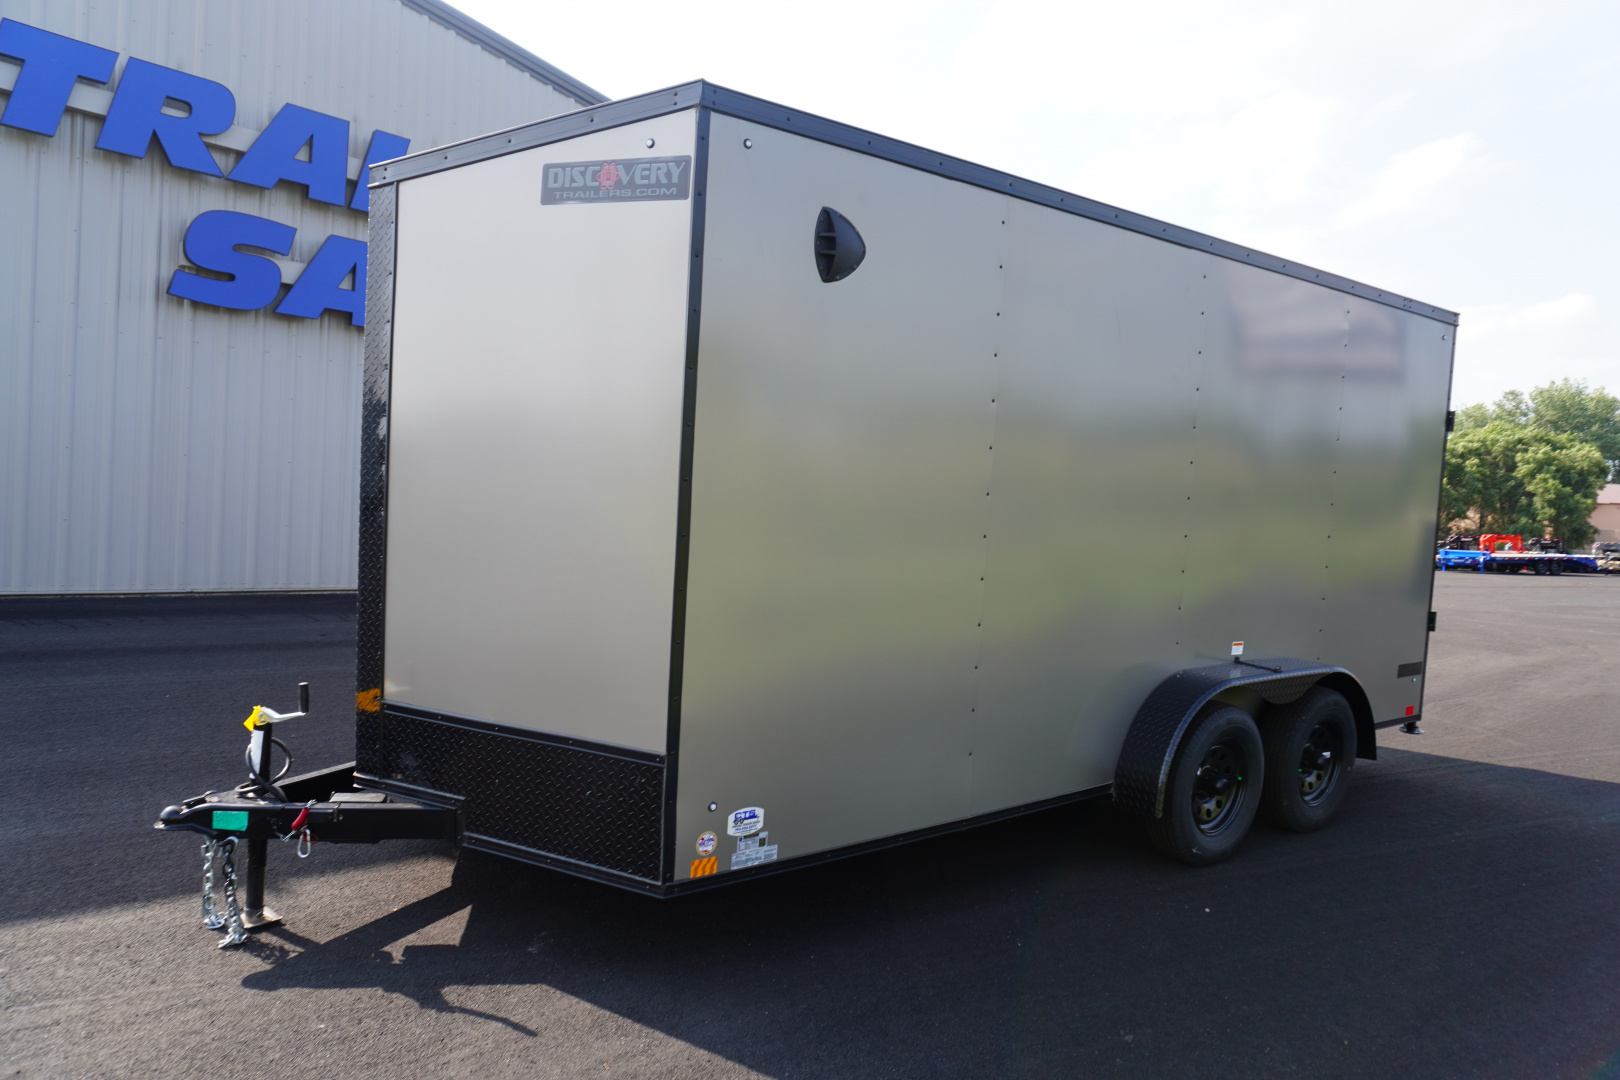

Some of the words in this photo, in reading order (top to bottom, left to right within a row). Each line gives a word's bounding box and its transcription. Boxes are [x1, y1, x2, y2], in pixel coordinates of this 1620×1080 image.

[548, 161, 686, 189] DISCOVERY
[553, 187, 677, 199] TRAILERS.COM
[734, 809, 757, 820] CTS
